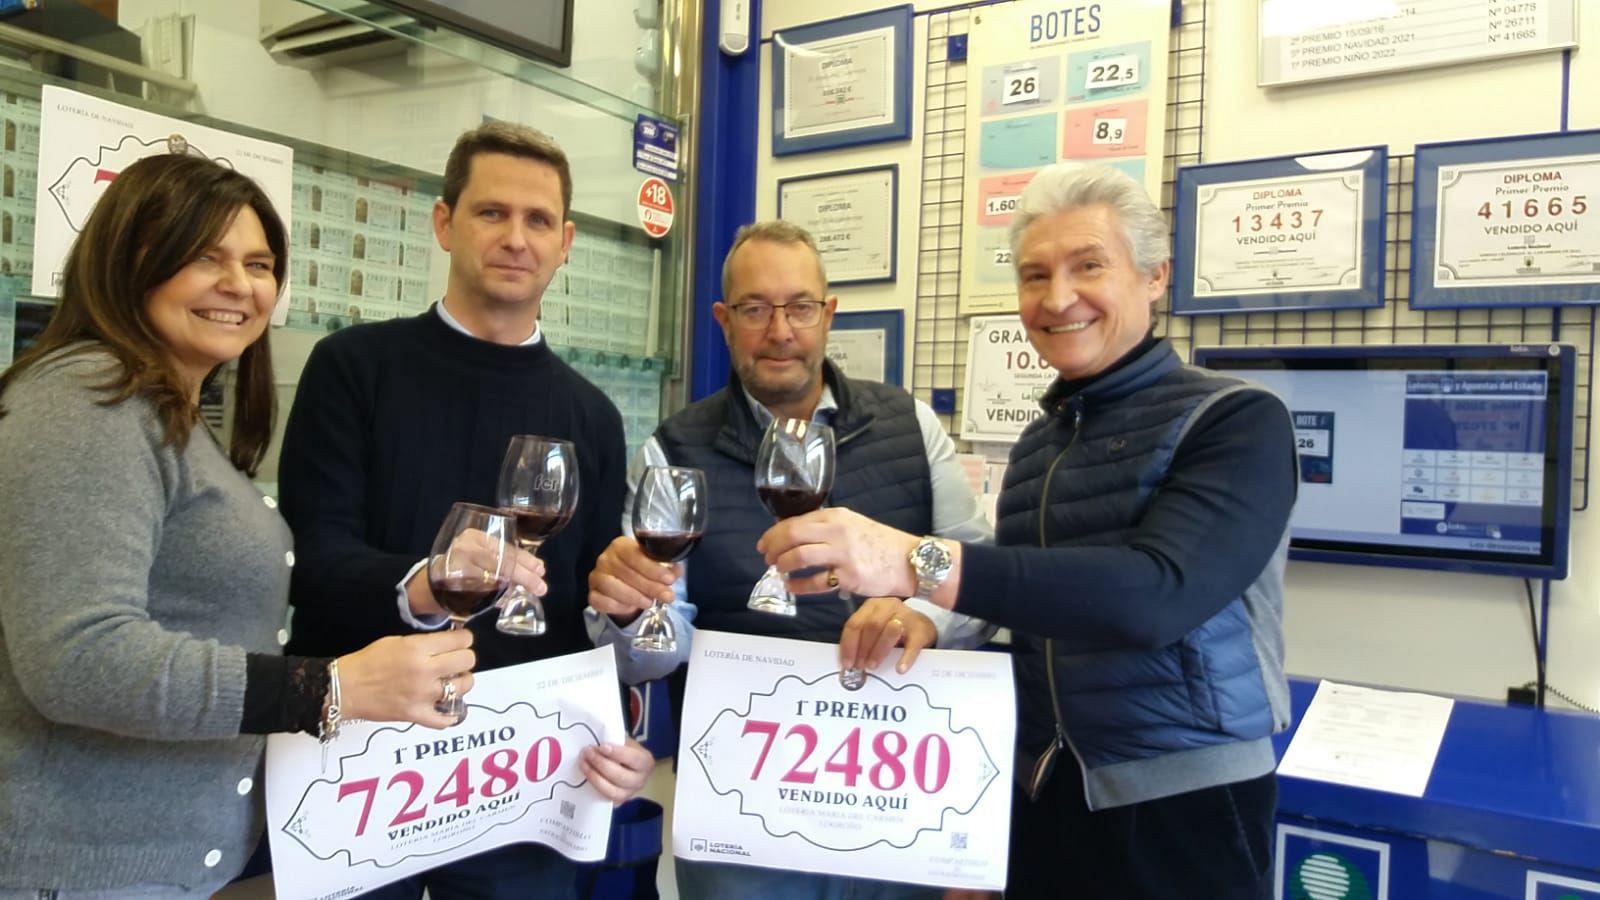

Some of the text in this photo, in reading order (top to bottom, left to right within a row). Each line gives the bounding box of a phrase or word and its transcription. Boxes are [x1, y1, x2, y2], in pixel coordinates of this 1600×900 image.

[1029, 4, 1101, 43] BOTES
[1302, 31, 1342, 43] PREMIO
[1302, 43, 1342, 56] PREMIO
[1344, 36, 1390, 50] NAVIDAD
[1391, 33, 1416, 45] 2021
[1302, 55, 1342, 68] PREMIO
[1343, 50, 1370, 63] NIÑO
[1371, 48, 1397, 60] 2022
[1503, 29, 1537, 41] 41665
[1091, 64, 1134, 83] 22,5
[1009, 77, 1036, 97] 26
[1096, 122, 1123, 141] 8,9
[1503, 171, 1563, 184] DIPLOMA
[1252, 188, 1303, 201] DIPLOMA
[1495, 183, 1569, 196] Primer Premio
[1484, 219, 1578, 236] VENDIDO AQUÍ
[1236, 233, 1287, 245] VENDIDO
[986, 408, 1041, 422] VENDID
[1298, 438, 1315, 449] 26
[703, 649, 796, 667] LOTERÍA DE NAVIDAD
[814, 700, 908, 723] PREMIO
[415, 726, 516, 761] PREMIO
[740, 719, 951, 794] 72480
[336, 736, 563, 838] 72480
[778, 787, 910, 812] VENDIDO AQUÍ
[387, 790, 522, 841] VENDIDO AQUÍ
[709, 847, 752, 857] NACIONAL
